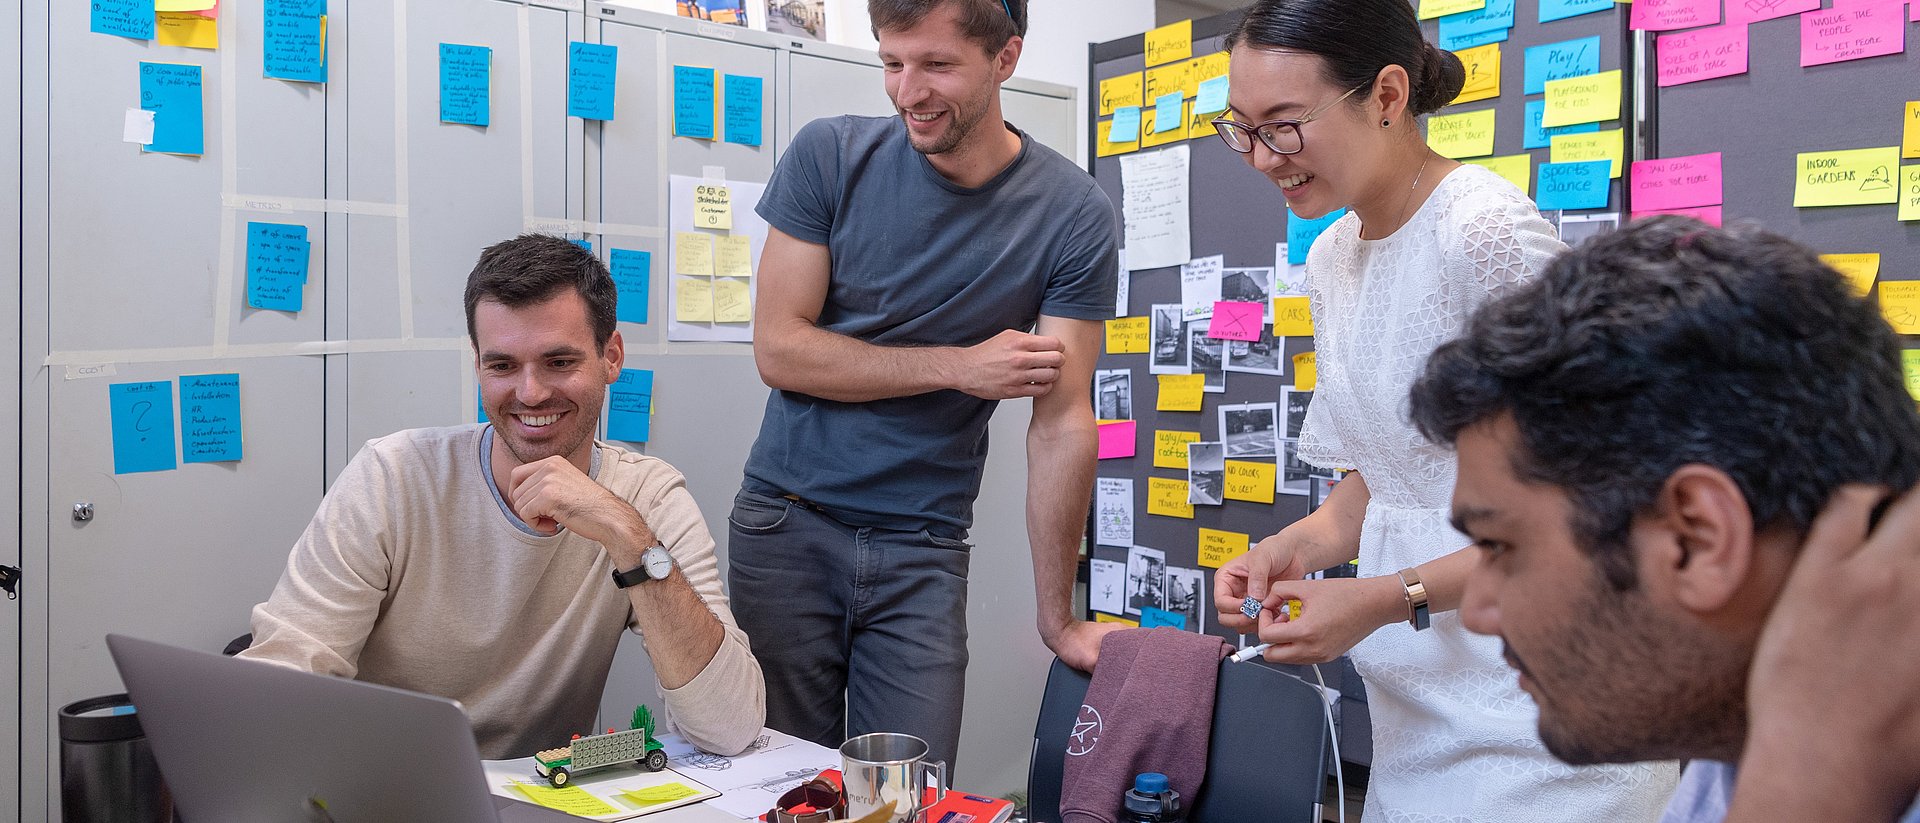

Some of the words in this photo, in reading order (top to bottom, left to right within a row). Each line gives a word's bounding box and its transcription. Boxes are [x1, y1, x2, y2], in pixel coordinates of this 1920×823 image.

[1810, 14, 1846, 27] INVOLVE
[1854, 9, 1873, 19] THE
[1819, 25, 1853, 37] PEOPLE
[1702, 49, 1711, 59] A
[1807, 159, 1840, 170] INDOOR
[1542, 162, 1590, 182] sports
[1807, 170, 1856, 185] GARDENS
[1546, 180, 1592, 193] dance
[245, 200, 282, 210] METRICS
